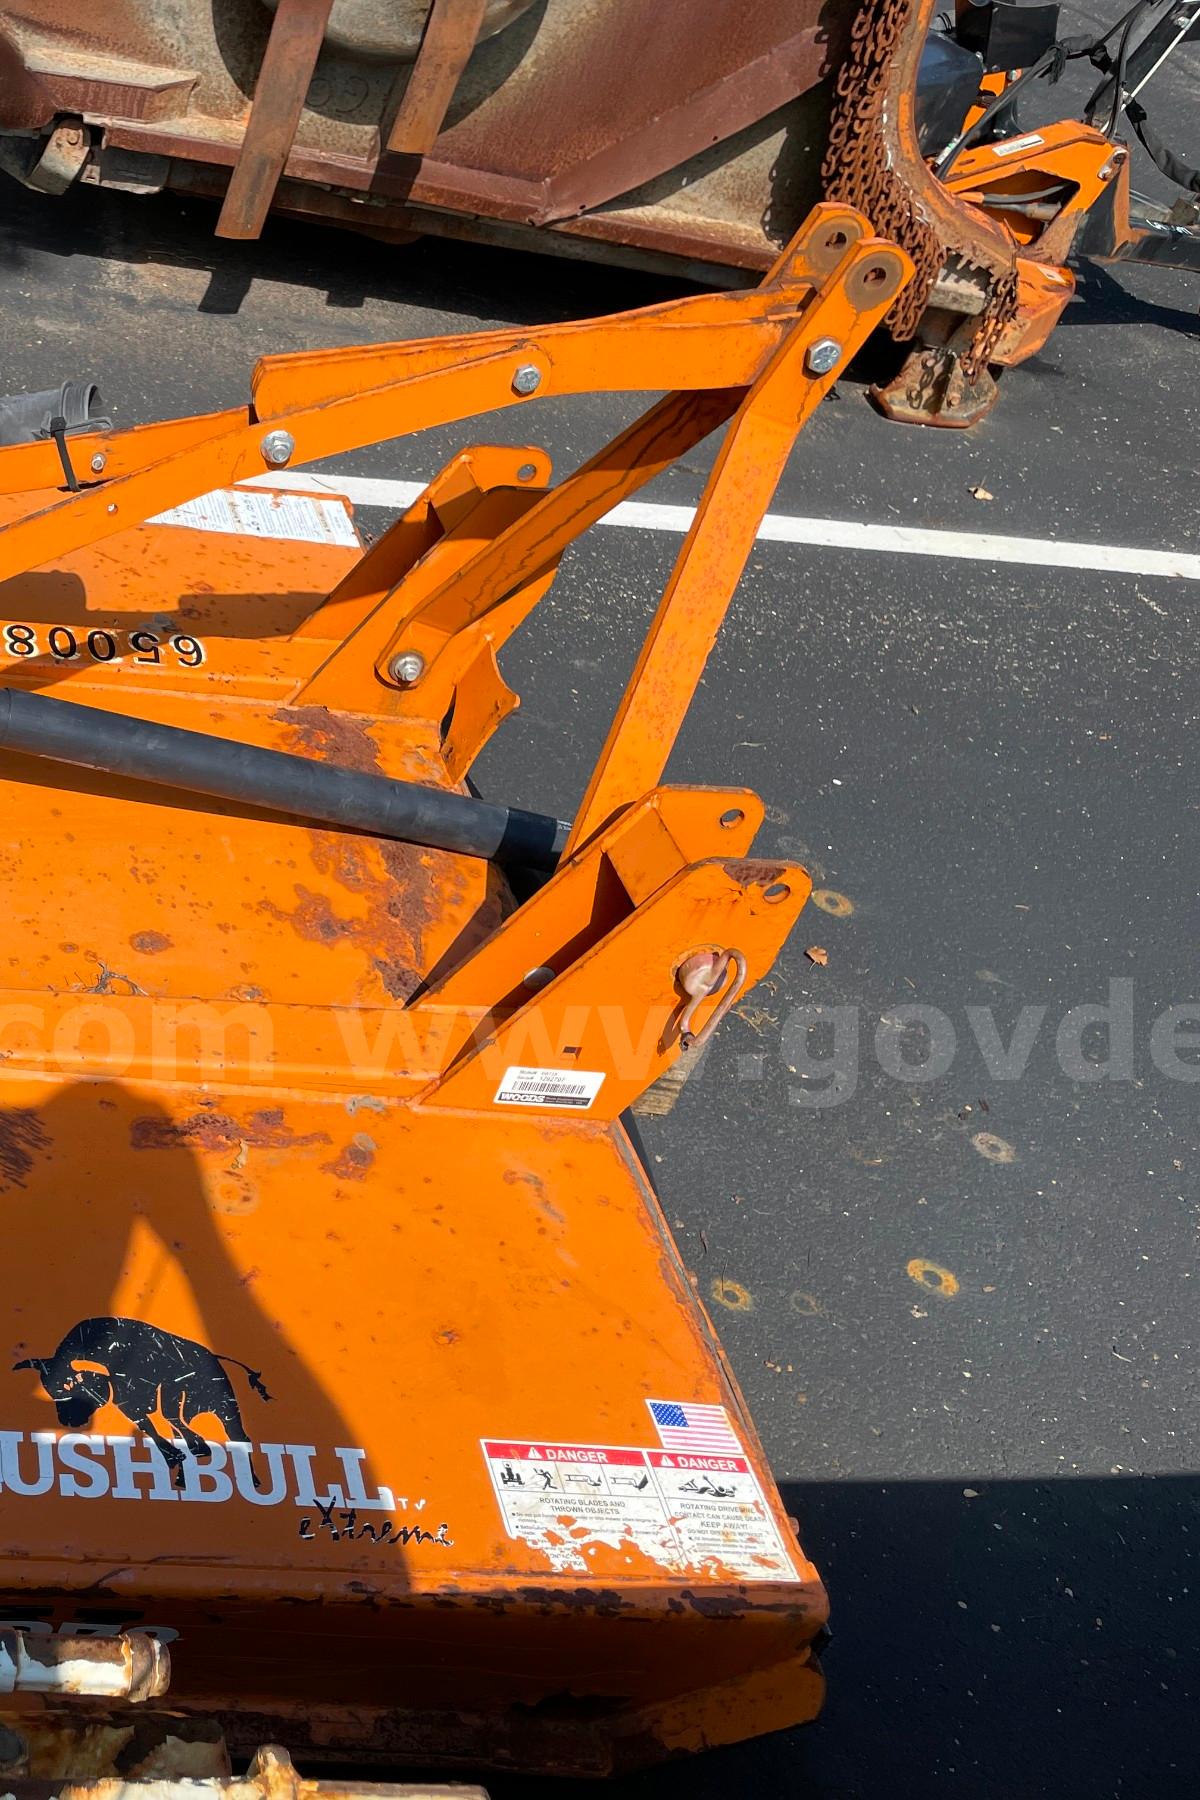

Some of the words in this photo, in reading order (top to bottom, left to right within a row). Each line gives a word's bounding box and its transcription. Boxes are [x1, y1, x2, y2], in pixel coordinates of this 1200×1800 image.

[500, 1093, 546, 1102] WOODS
[545, 1449, 609, 1463] DANGER
[677, 1457, 739, 1471] DANGER
[539, 1497, 577, 1506] ROTATING
[579, 1499, 609, 1507] BLADES
[550, 1505, 584, 1513] THROWN
[585, 1507, 620, 1515] OBJECTS
[680, 1503, 717, 1512] ROTATING
[700, 1520, 721, 1529] KEEP
